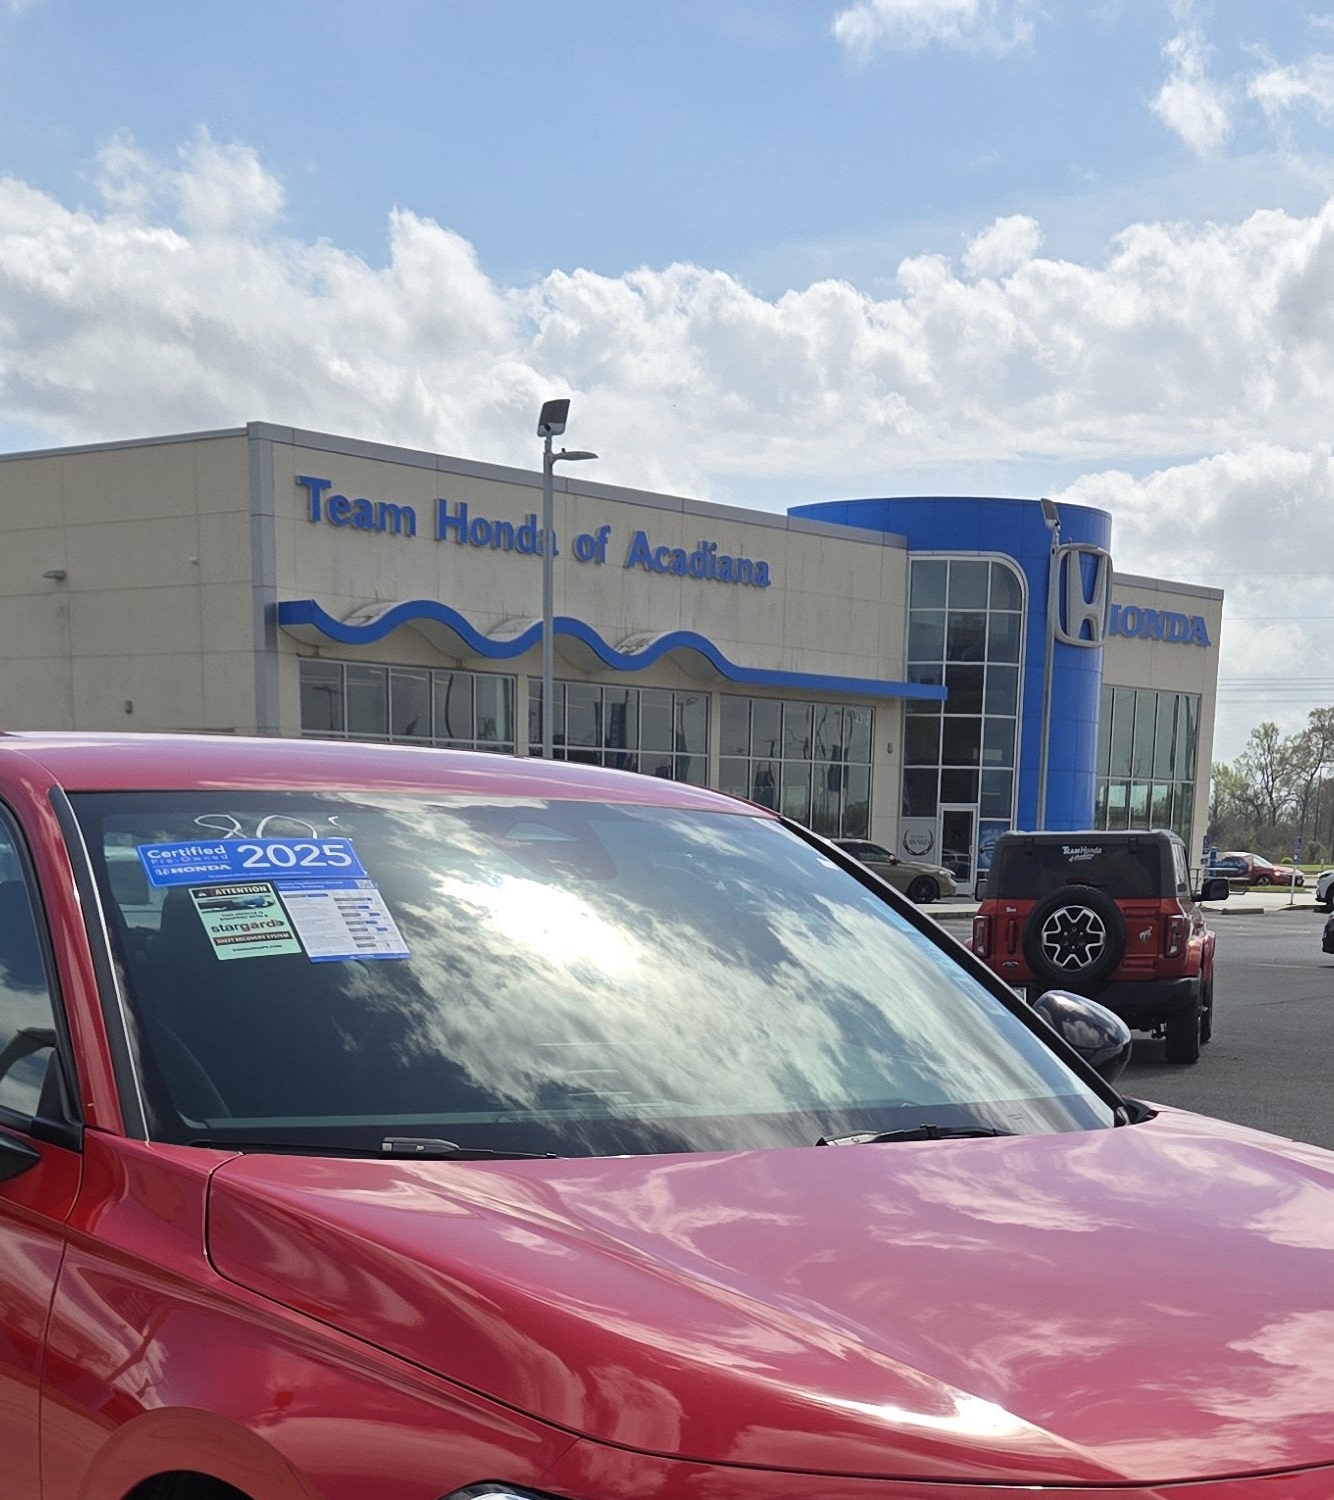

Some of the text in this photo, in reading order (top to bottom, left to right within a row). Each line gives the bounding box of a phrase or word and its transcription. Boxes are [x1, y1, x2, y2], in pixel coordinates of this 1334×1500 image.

[296, 475, 416, 537] Team
[573, 524, 611, 564] of
[623, 530, 771, 588] Acadiana
[147, 845, 226, 858] Certified
[237, 844, 352, 868] 2025
[150, 855, 228, 864] Pre-Owned
[170, 864, 232, 874] HONDA
[215, 885, 268, 896] ATTENTION
